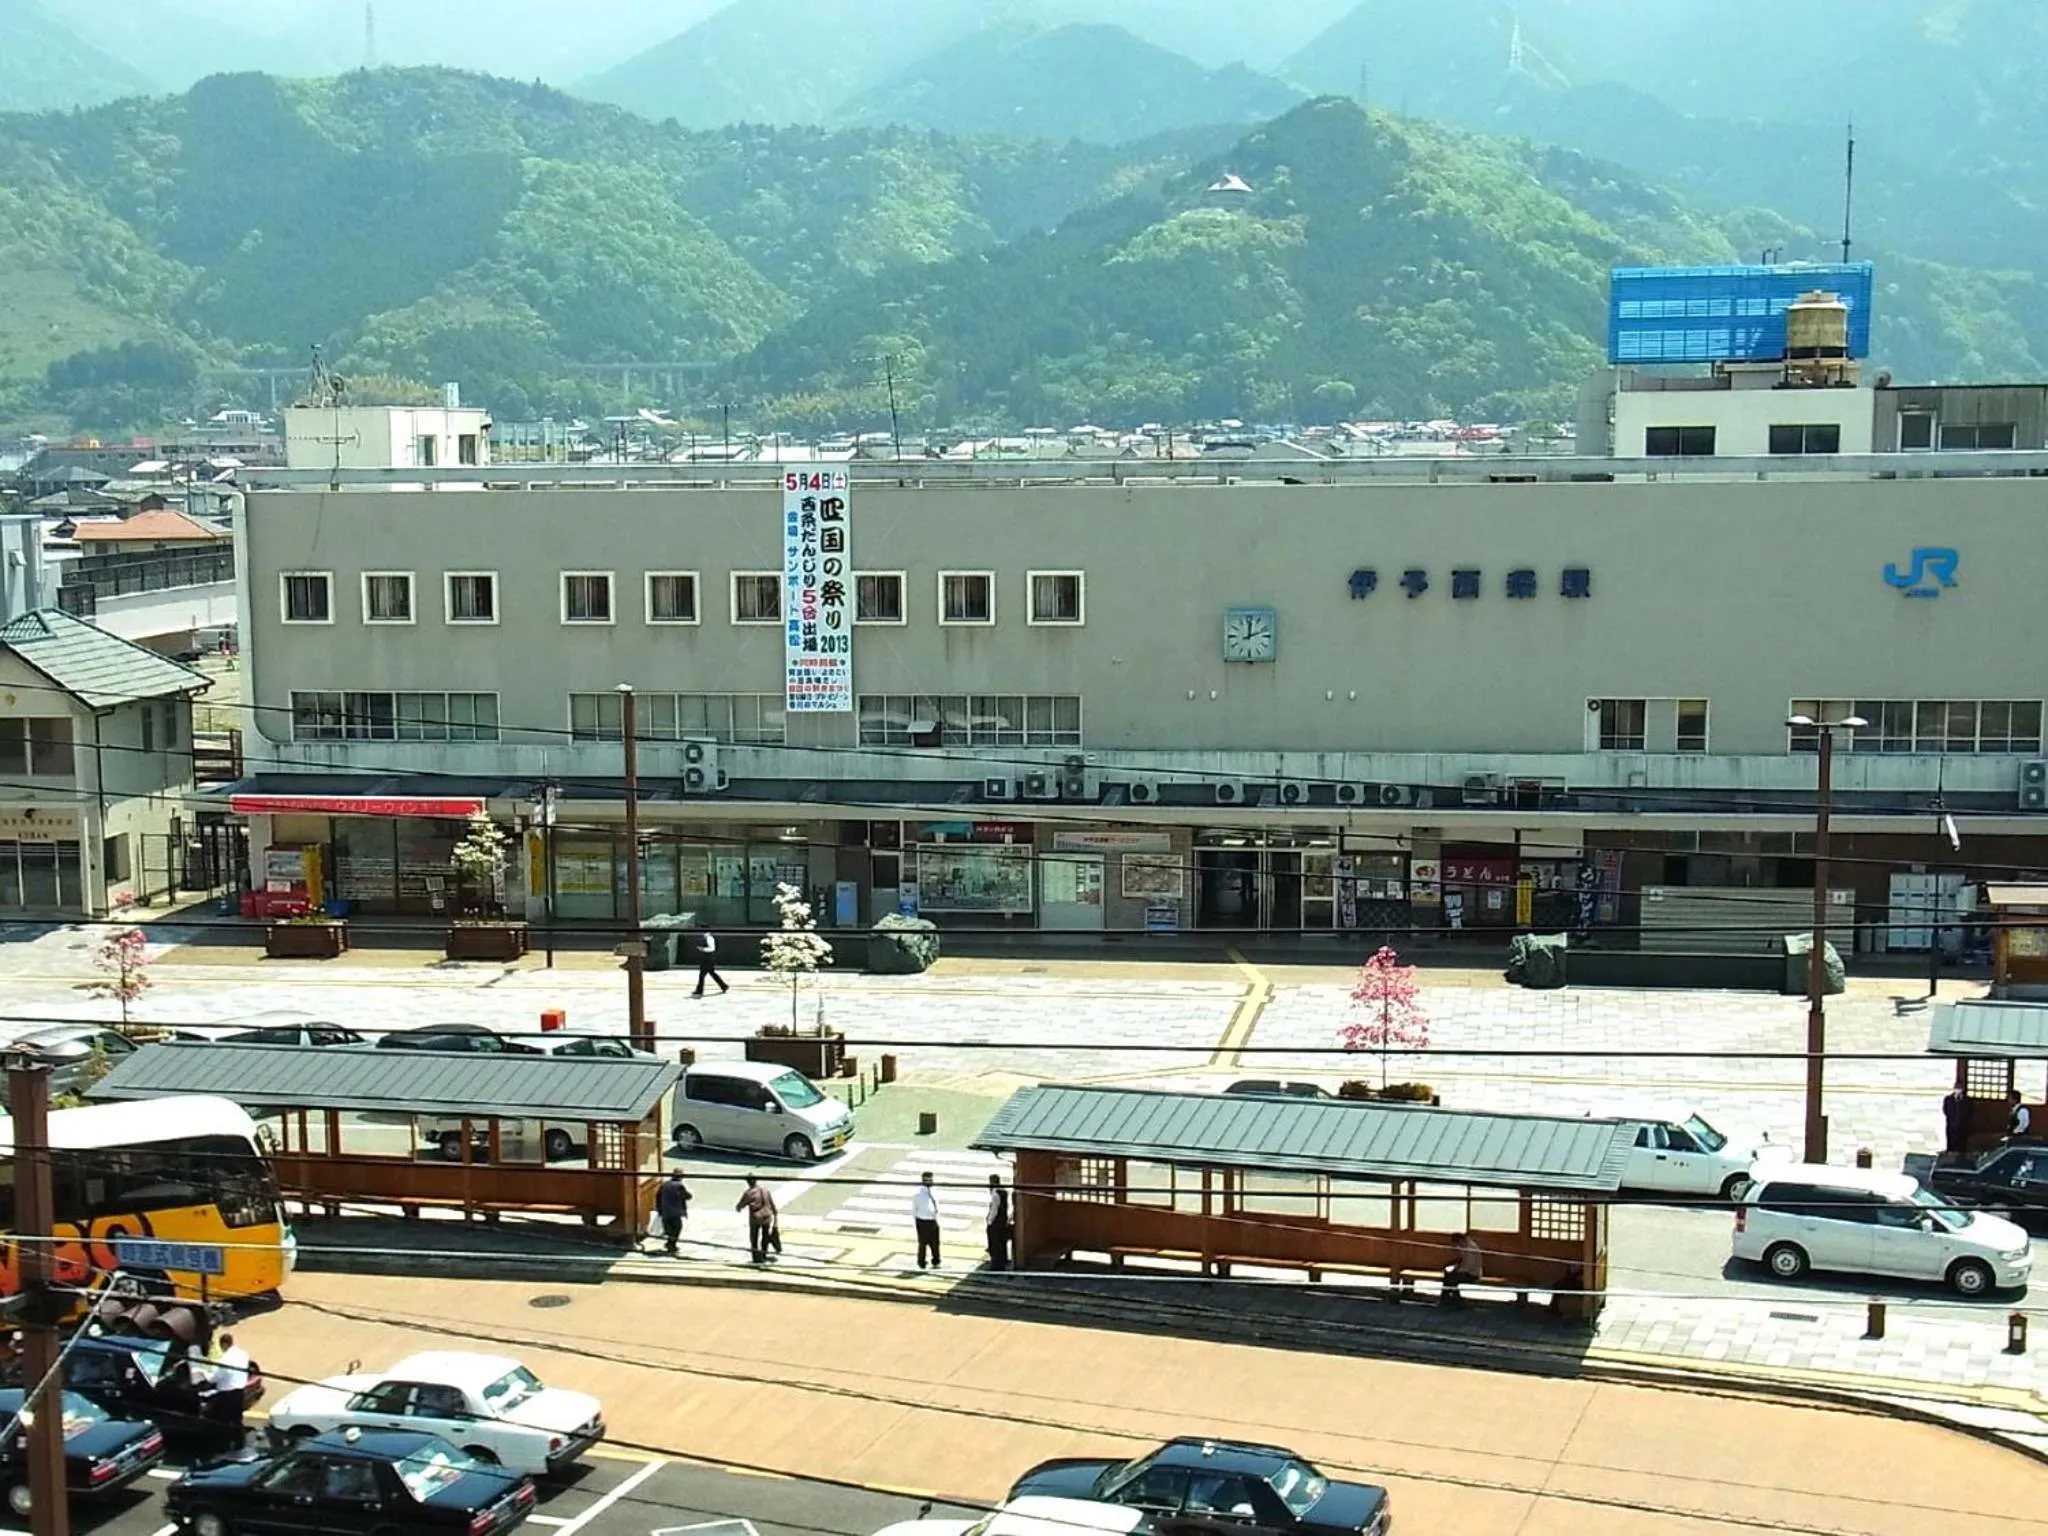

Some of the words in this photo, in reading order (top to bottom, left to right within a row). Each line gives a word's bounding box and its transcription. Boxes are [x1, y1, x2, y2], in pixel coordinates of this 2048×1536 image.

[788, 546, 800, 646] サンポート高松
[801, 497, 818, 652] 西条だんじり5台出場
[820, 497, 846, 630] 四国の祭り
[1883, 547, 1959, 587] JR
[820, 635, 848, 653] 2013
[1444, 866, 1492, 881] うどん
